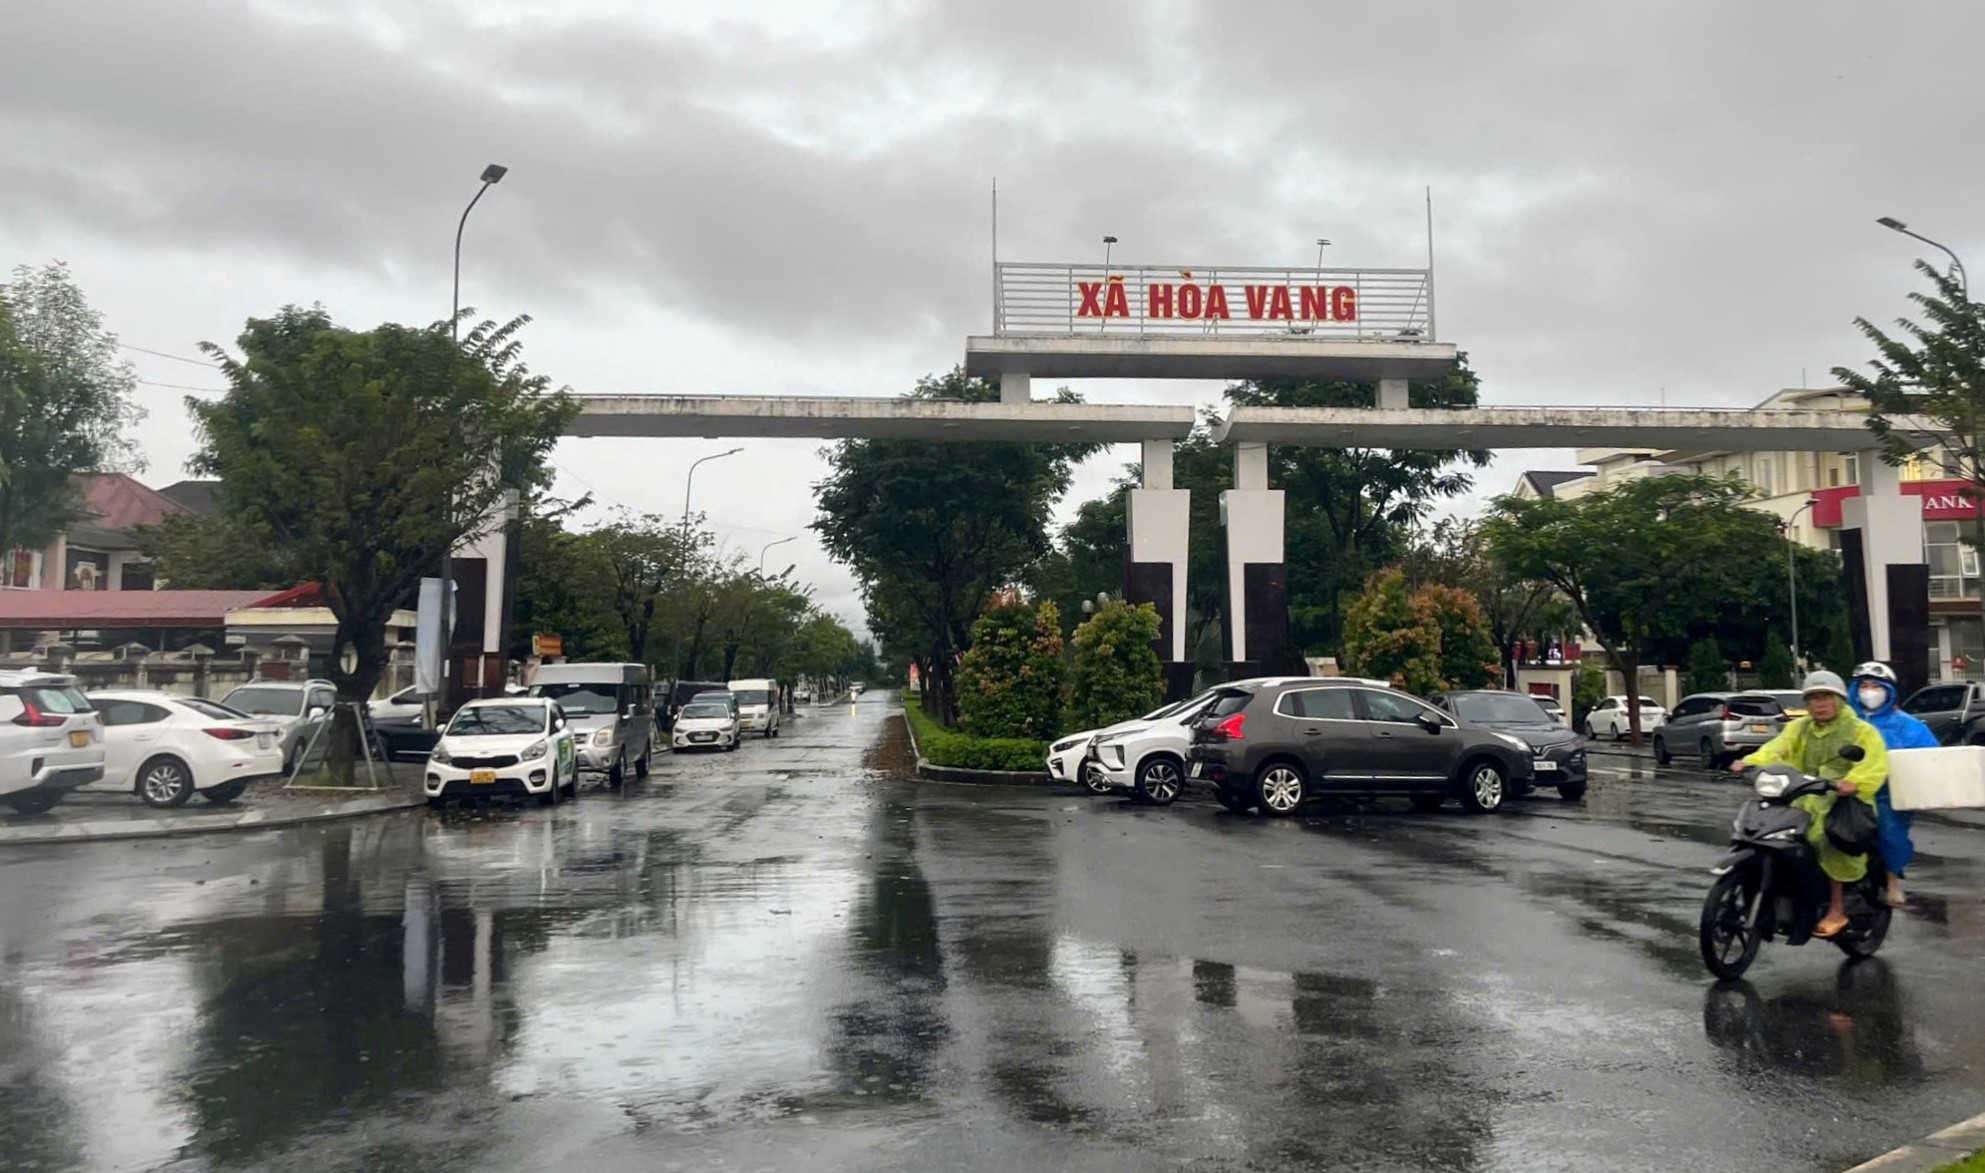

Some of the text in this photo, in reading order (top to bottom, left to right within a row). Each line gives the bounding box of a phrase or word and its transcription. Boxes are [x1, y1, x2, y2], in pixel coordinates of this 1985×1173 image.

[1076, 269, 1358, 322] XÃ HÒA VANG
